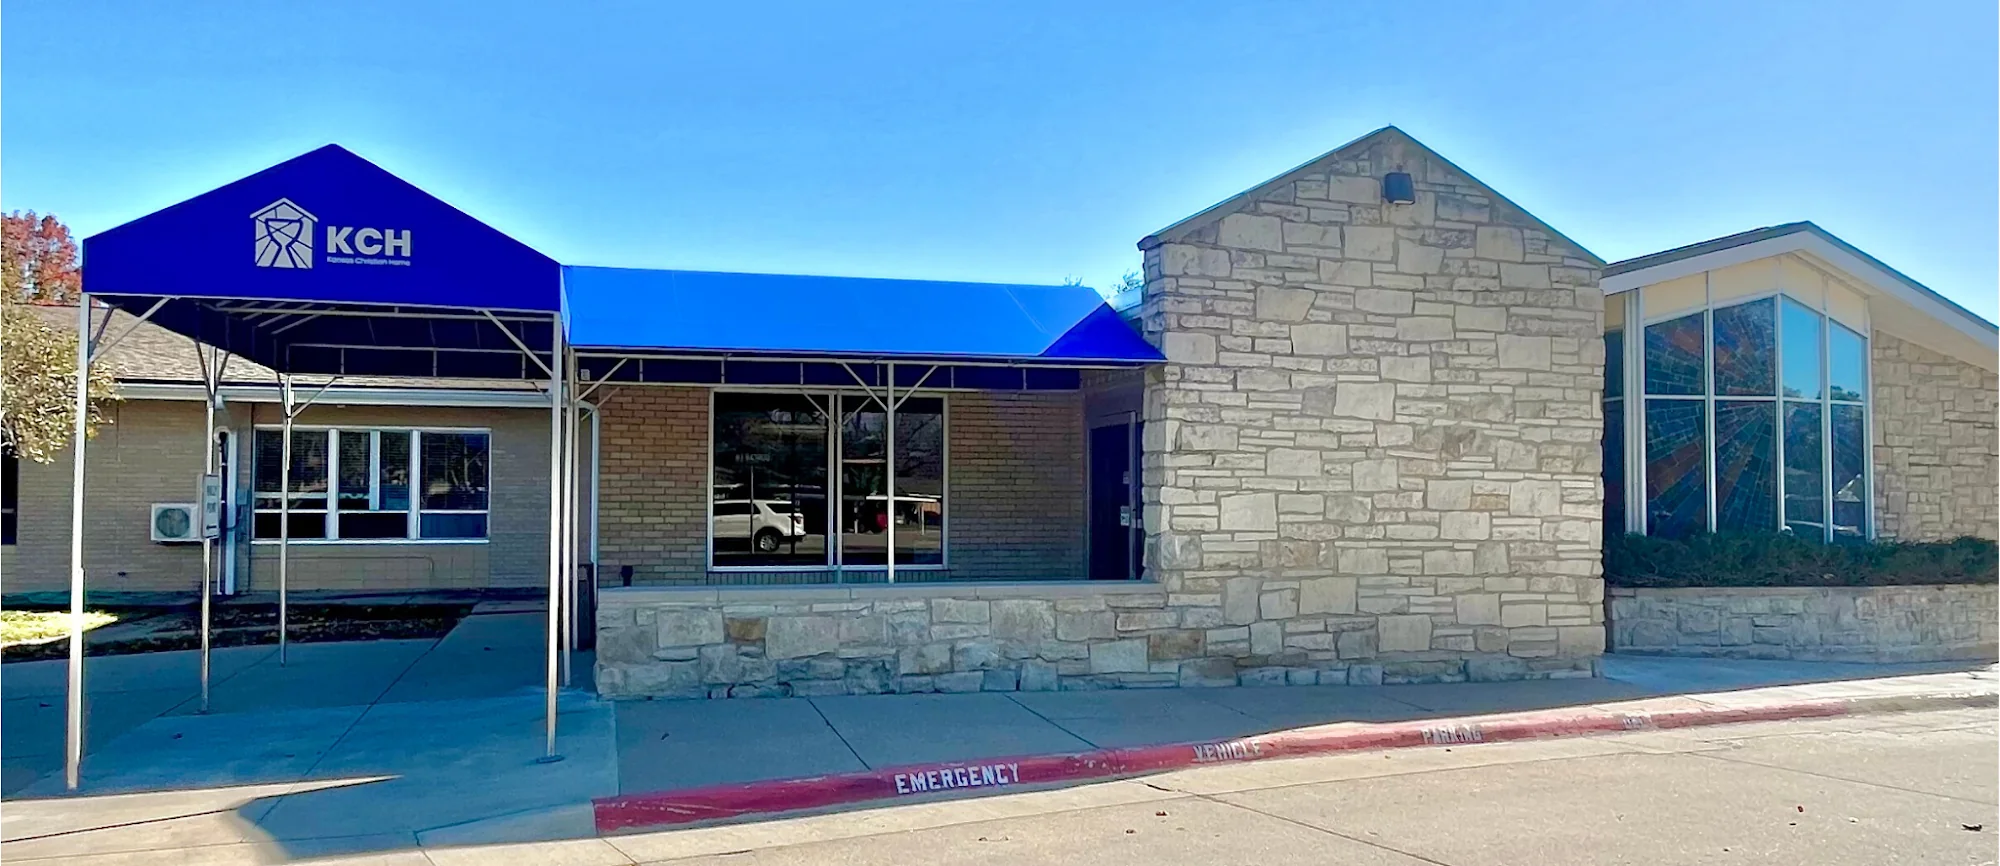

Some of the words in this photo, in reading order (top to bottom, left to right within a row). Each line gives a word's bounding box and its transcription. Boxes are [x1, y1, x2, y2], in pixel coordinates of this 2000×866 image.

[327, 225, 411, 257] KCH
[327, 256, 354, 264] Kansas
[355, 257, 387, 265] Christian
[388, 259, 411, 267] Home
[895, 763, 1019, 794] EMERGENCY
[1420, 725, 1482, 744] PARKING
